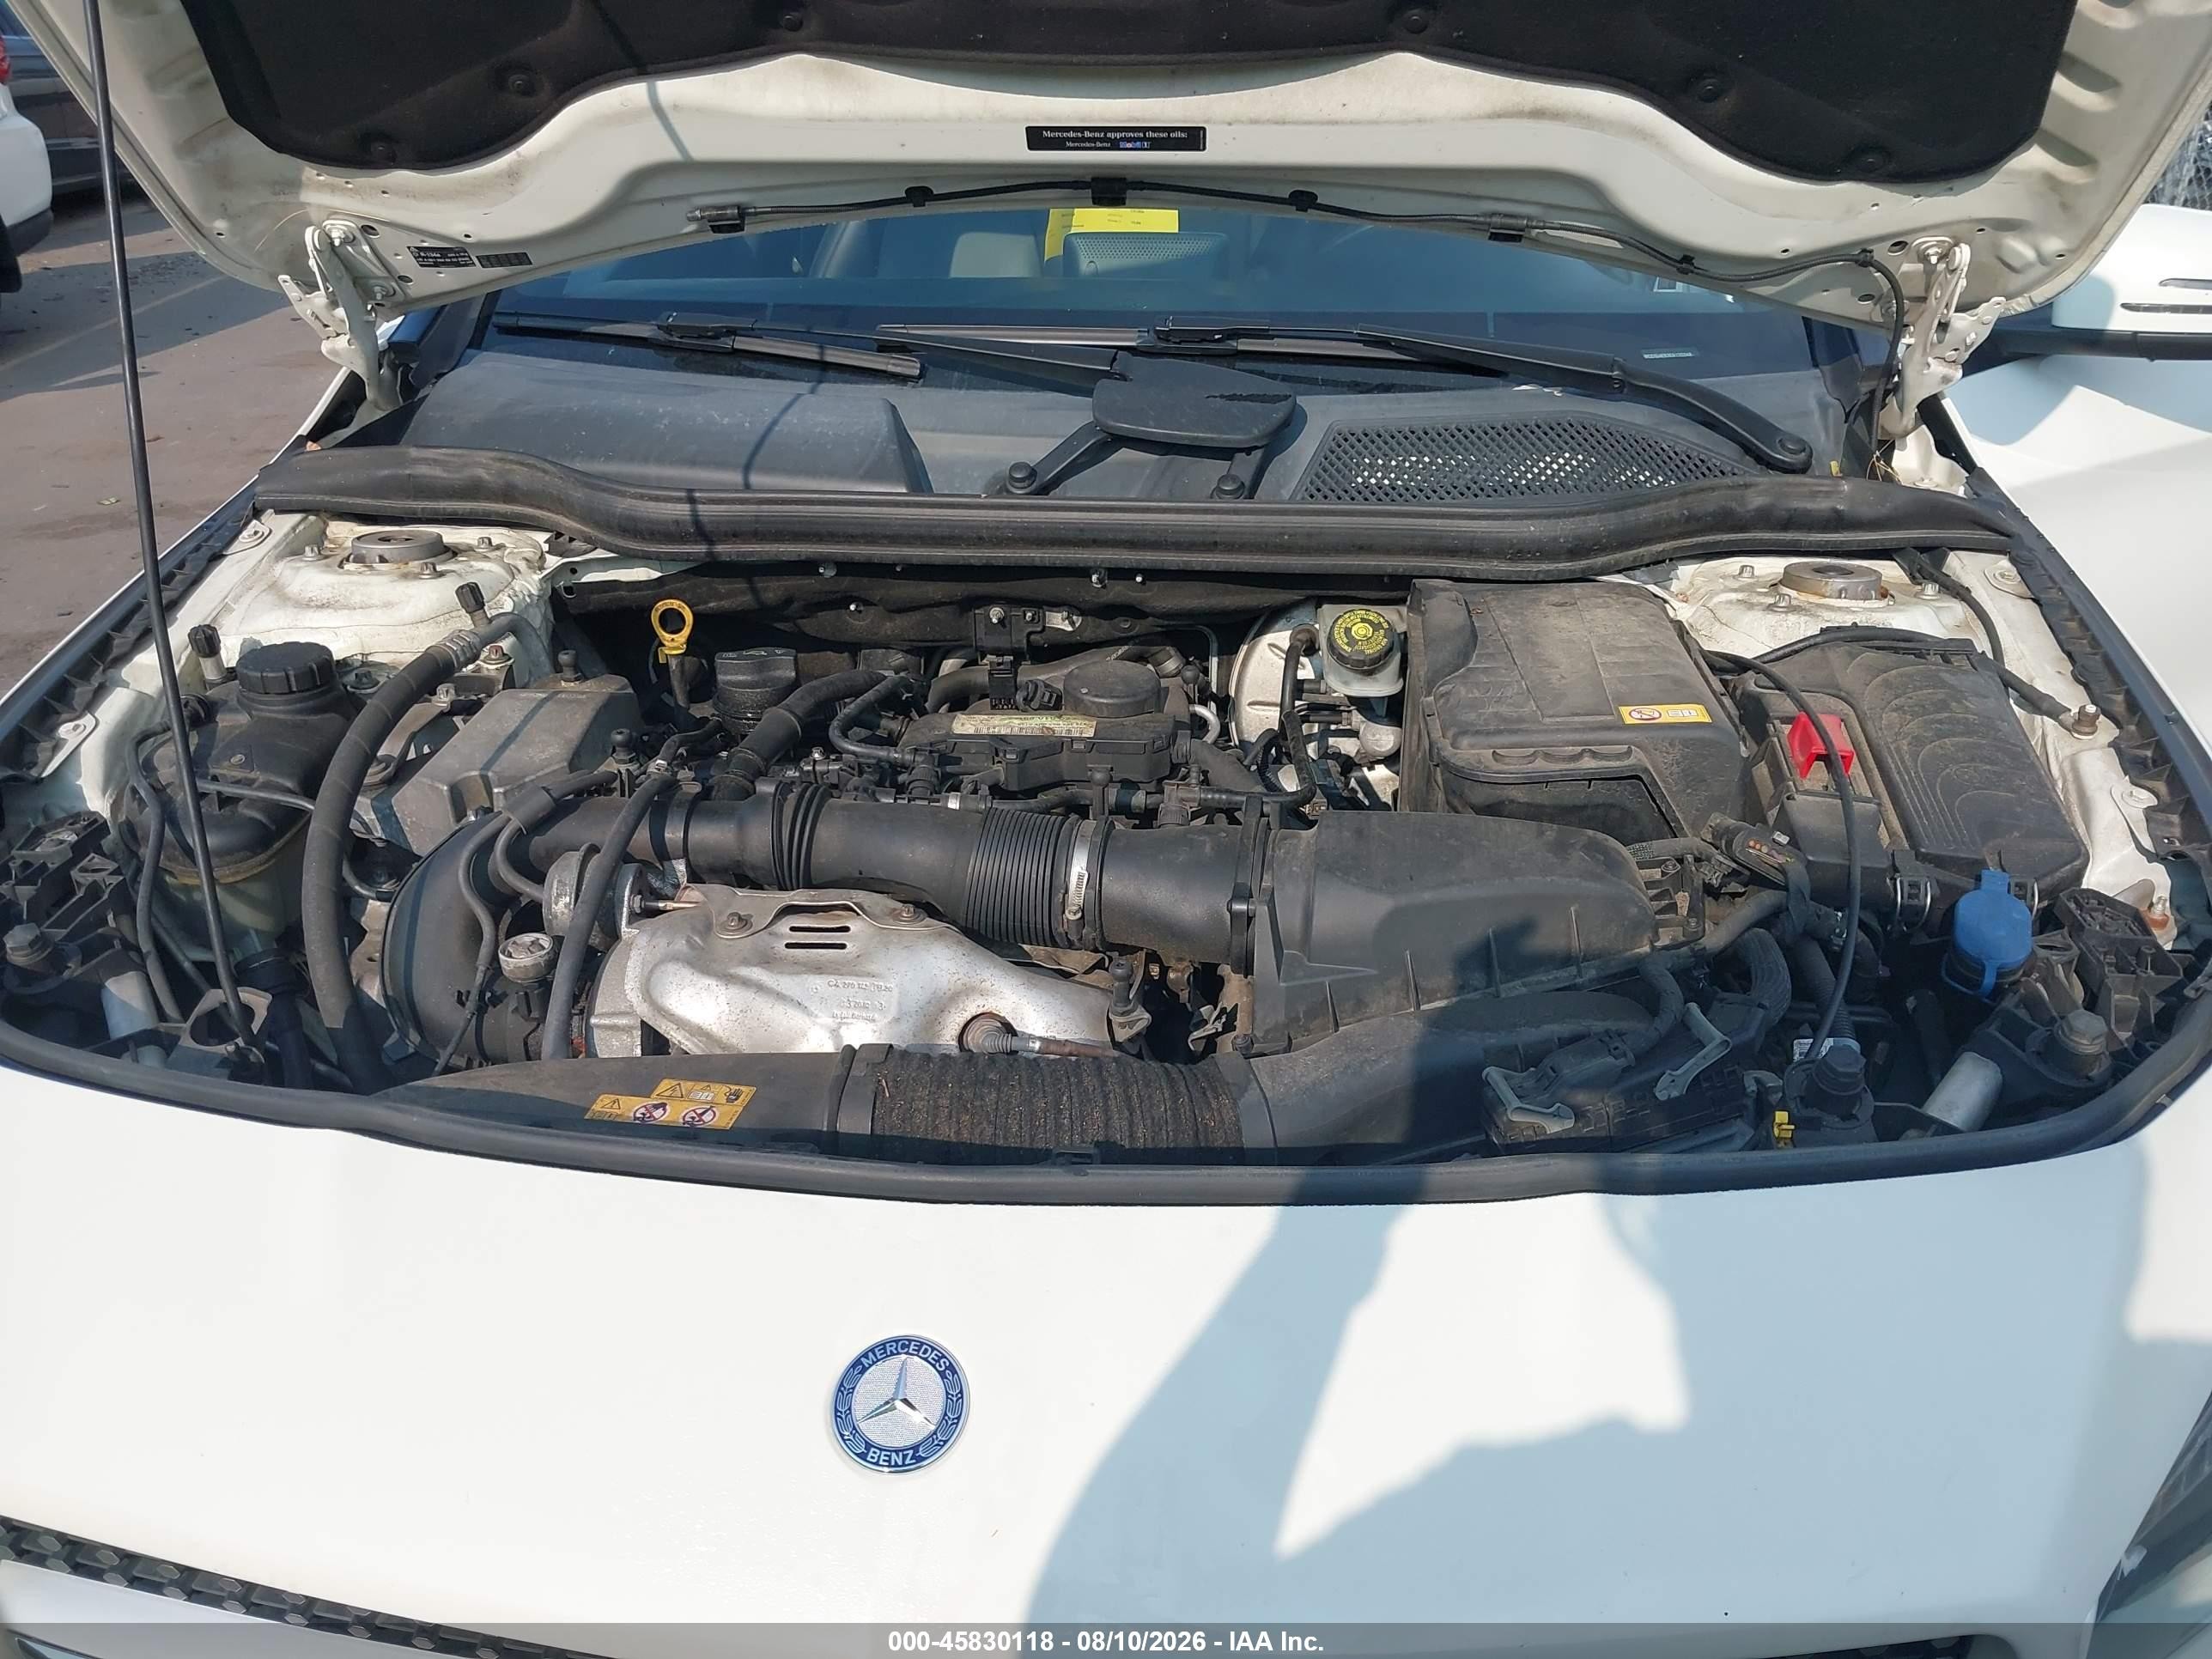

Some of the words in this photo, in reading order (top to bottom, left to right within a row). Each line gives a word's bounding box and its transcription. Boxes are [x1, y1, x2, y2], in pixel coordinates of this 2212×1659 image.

[1042, 130, 1105, 138] Mercedes-Benz
[1106, 131, 1144, 140] approves
[1146, 130, 1169, 138] these
[1170, 130, 1188, 138] oils:
[860, 1340, 951, 1371] MERCEDES
[866, 1449, 917, 1468] BENZ
